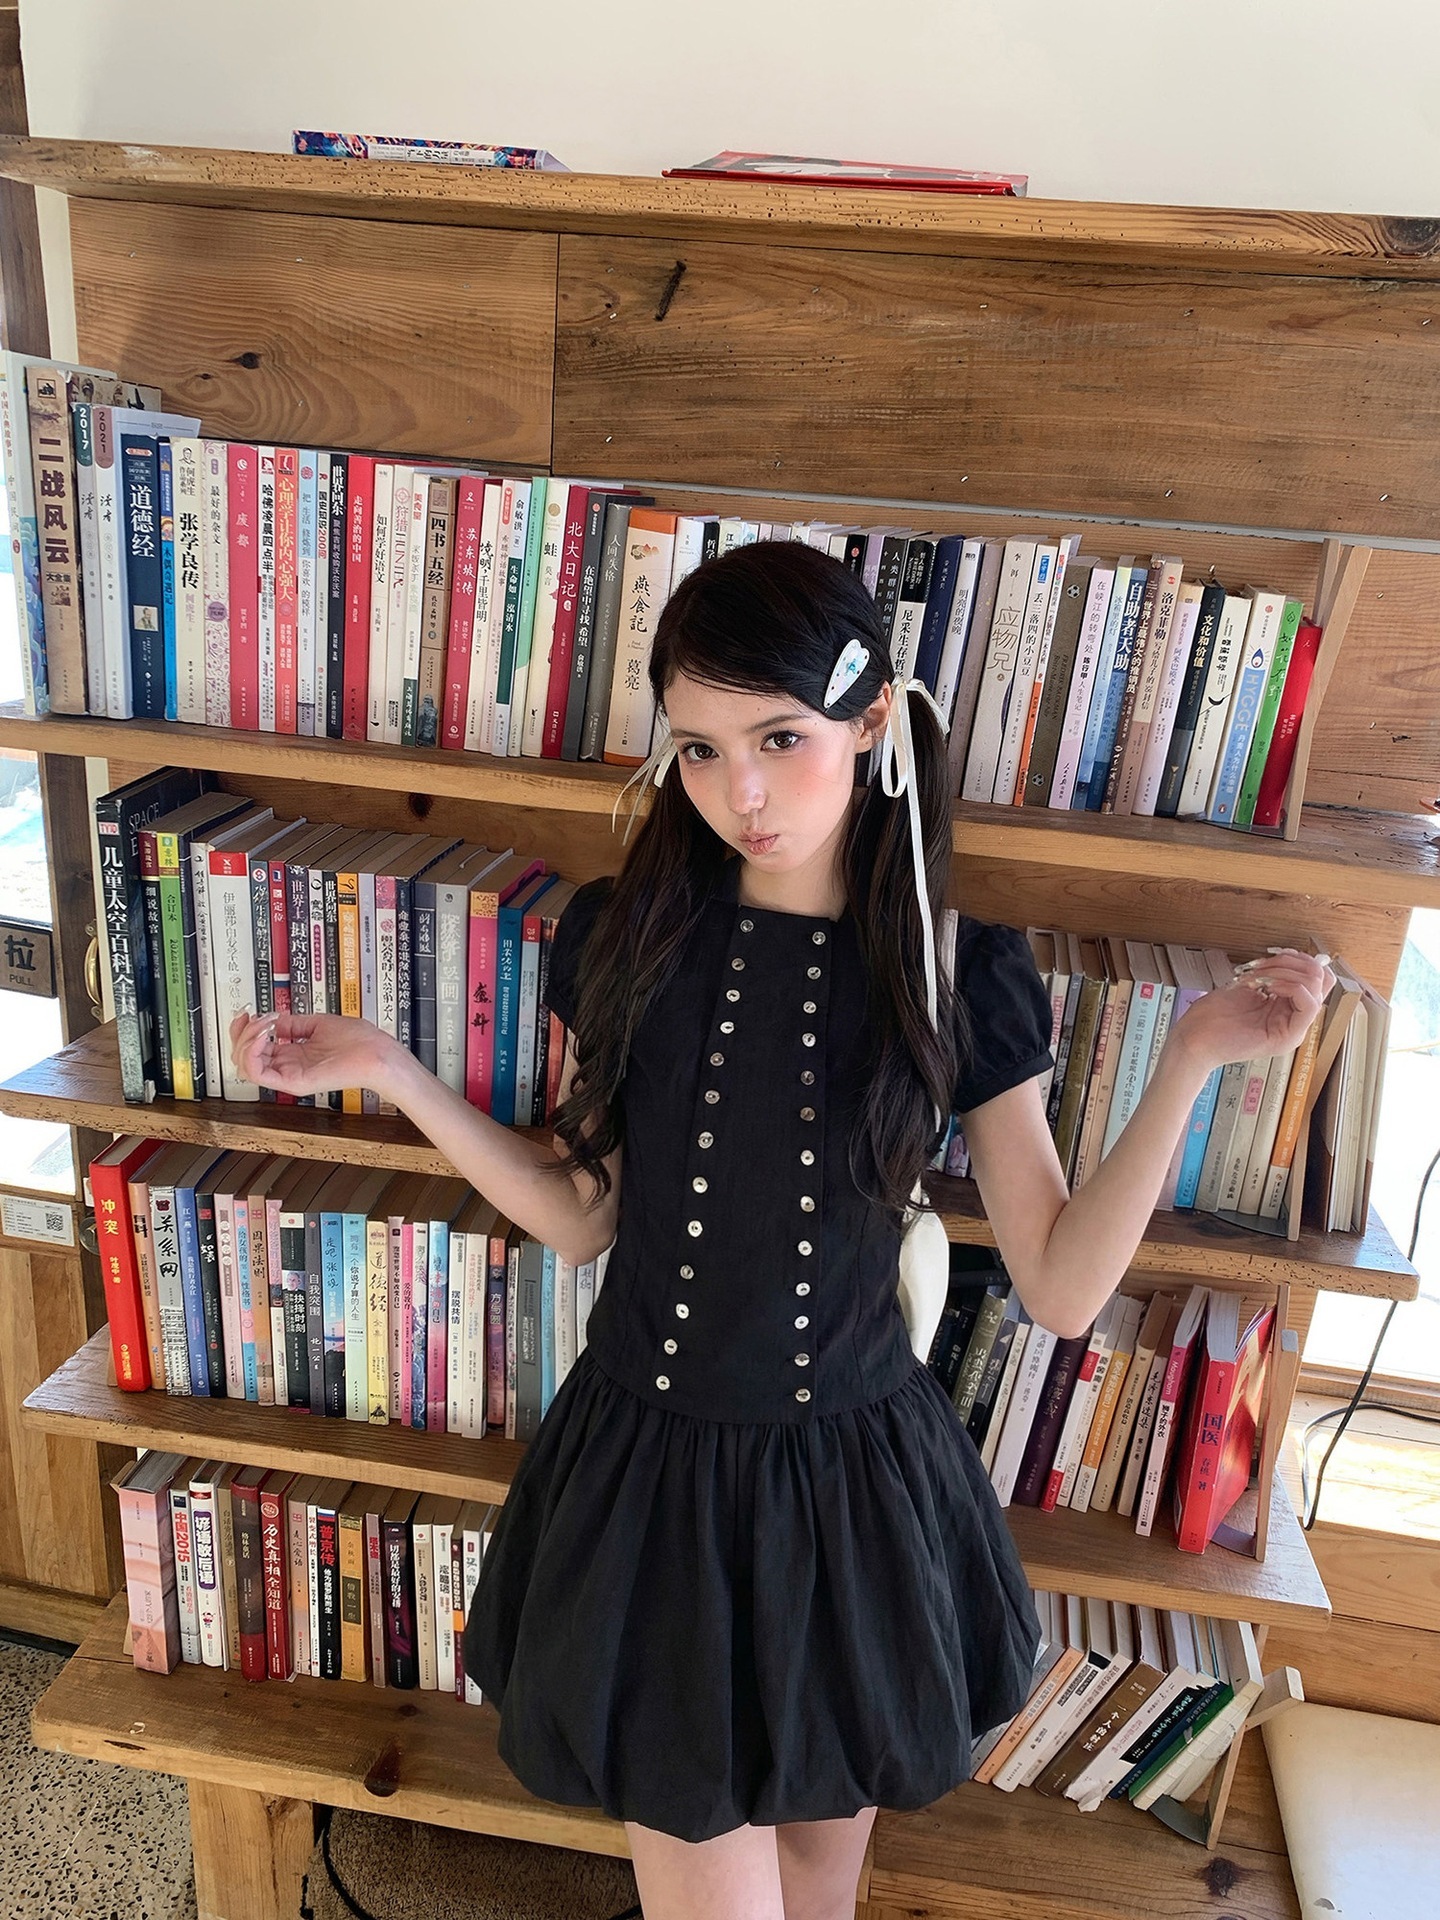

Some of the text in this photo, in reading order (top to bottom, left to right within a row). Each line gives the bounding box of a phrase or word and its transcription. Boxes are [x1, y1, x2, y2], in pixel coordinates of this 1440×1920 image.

[79, 408, 89, 450] 2017
[98, 411, 108, 453] 2021
[38, 437, 70, 564] 二战风云
[130, 484, 155, 559] 道德经
[211, 486, 221, 545] 最好的杂文
[513, 500, 524, 532] 俞敏洪
[178, 513, 200, 590] 张学良传
[236, 512, 249, 548] 废都
[262, 484, 274, 573] 哈佛凌晨四点半
[278, 478, 295, 601] 心理学让你内心强大
[352, 495, 364, 563] 走向善治的中国
[375, 514, 388, 585] 如何学好语文
[544, 542, 558, 558] 蛙
[46, 572, 71, 584] 大全集
[461, 528, 479, 596] 苏东坡传
[561, 522, 583, 598] 北大日记
[604, 534, 622, 582] 人间失格
[505, 565, 518, 632] 生命如一泓清水
[579, 564, 595, 648] 在绝望中寻找希望
[630, 575, 651, 633] 燕食記
[951, 589, 969, 636] 明亮的夜晚
[1083, 581, 1106, 654] 在峡江的转弯处
[1154, 592, 1174, 641] 洛克菲勒
[986, 606, 1021, 672] 应物兄
[1114, 582, 1143, 672] 自助者天助
[1126, 601, 1153, 695] 世界上最伟大的推销员
[1191, 615, 1213, 669] 文化和价值
[624, 658, 642, 691] 葛亮
[1080, 657, 1091, 680] 陈行甲
[1234, 673, 1259, 732] HYGGE
[128, 802, 160, 835] SPACE
[102, 846, 138, 1016] 儿童太空百科全书
[145, 886, 160, 935] 细说故宫
[166, 894, 179, 922] 合订本
[273, 901, 284, 923] 定位
[4, 935, 36, 971] 拉
[9, 974, 35, 987] PULL
[101, 1198, 120, 1236] 冲突
[182, 1207, 193, 1229] 江一燕
[154, 1214, 179, 1279] 关系网
[251, 1231, 264, 1278] 因果法则
[308, 1274, 320, 1317] 自我突围
[369, 1251, 388, 1313] 道德经
[293, 1293, 306, 1334] 抉择时刻
[451, 1290, 461, 1325] 摆脱共情
[1138, 1369, 1160, 1431] 毛泽东选集
[1165, 1360, 1179, 1396] Maugham
[1201, 1412, 1223, 1447] 国医
[174, 1511, 191, 1563] 中国2015
[320, 1524, 335, 1567] 普京传
[263, 1523, 282, 1610] 历史真相全知道
